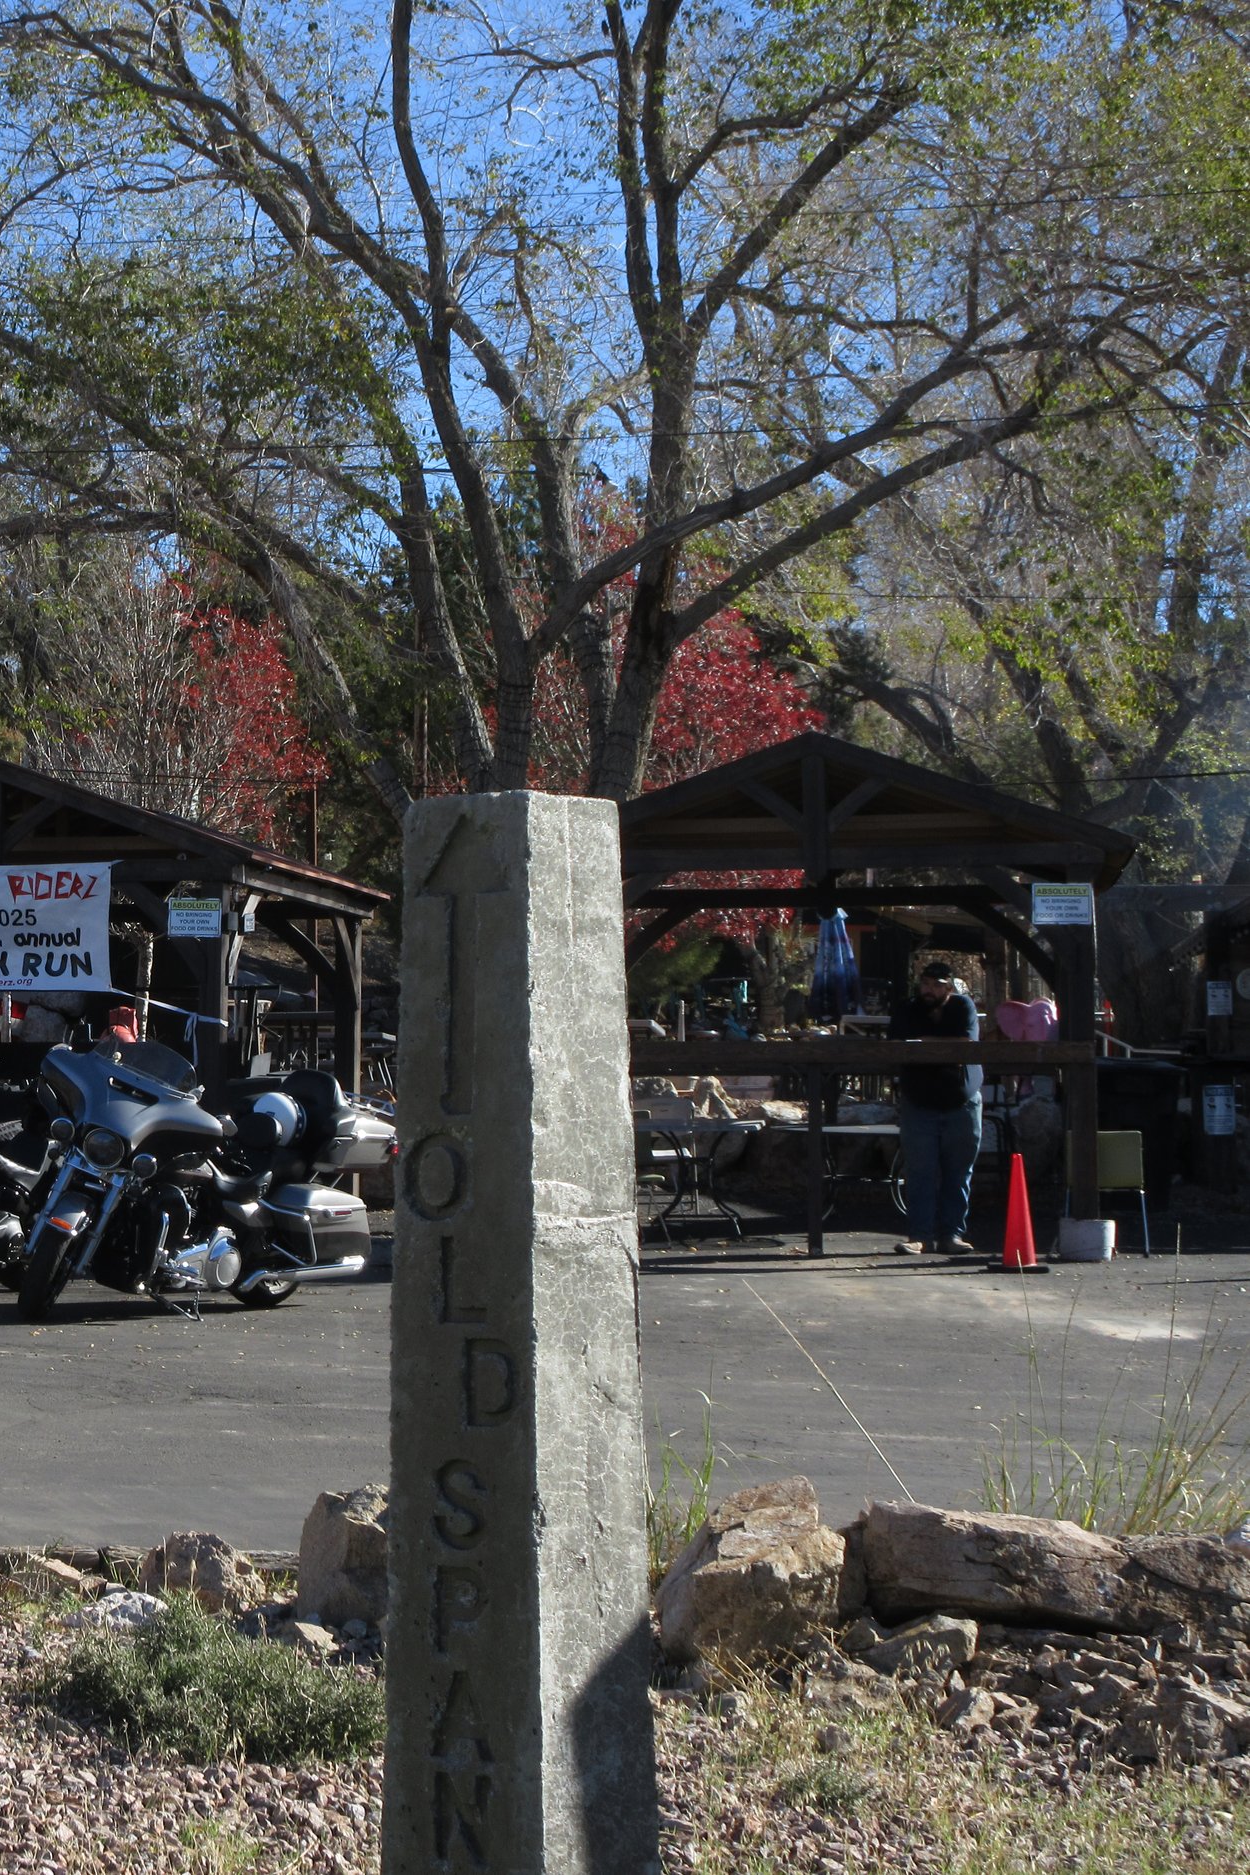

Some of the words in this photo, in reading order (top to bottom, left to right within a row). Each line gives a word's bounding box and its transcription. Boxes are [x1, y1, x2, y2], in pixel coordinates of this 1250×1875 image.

[7, 871, 99, 904] RIDERZ
[14, 928, 81, 948] annual
[22, 951, 93, 978] RUN
[403, 1132, 518, 1430] OLD
[431, 1458, 494, 1872] SPAN
